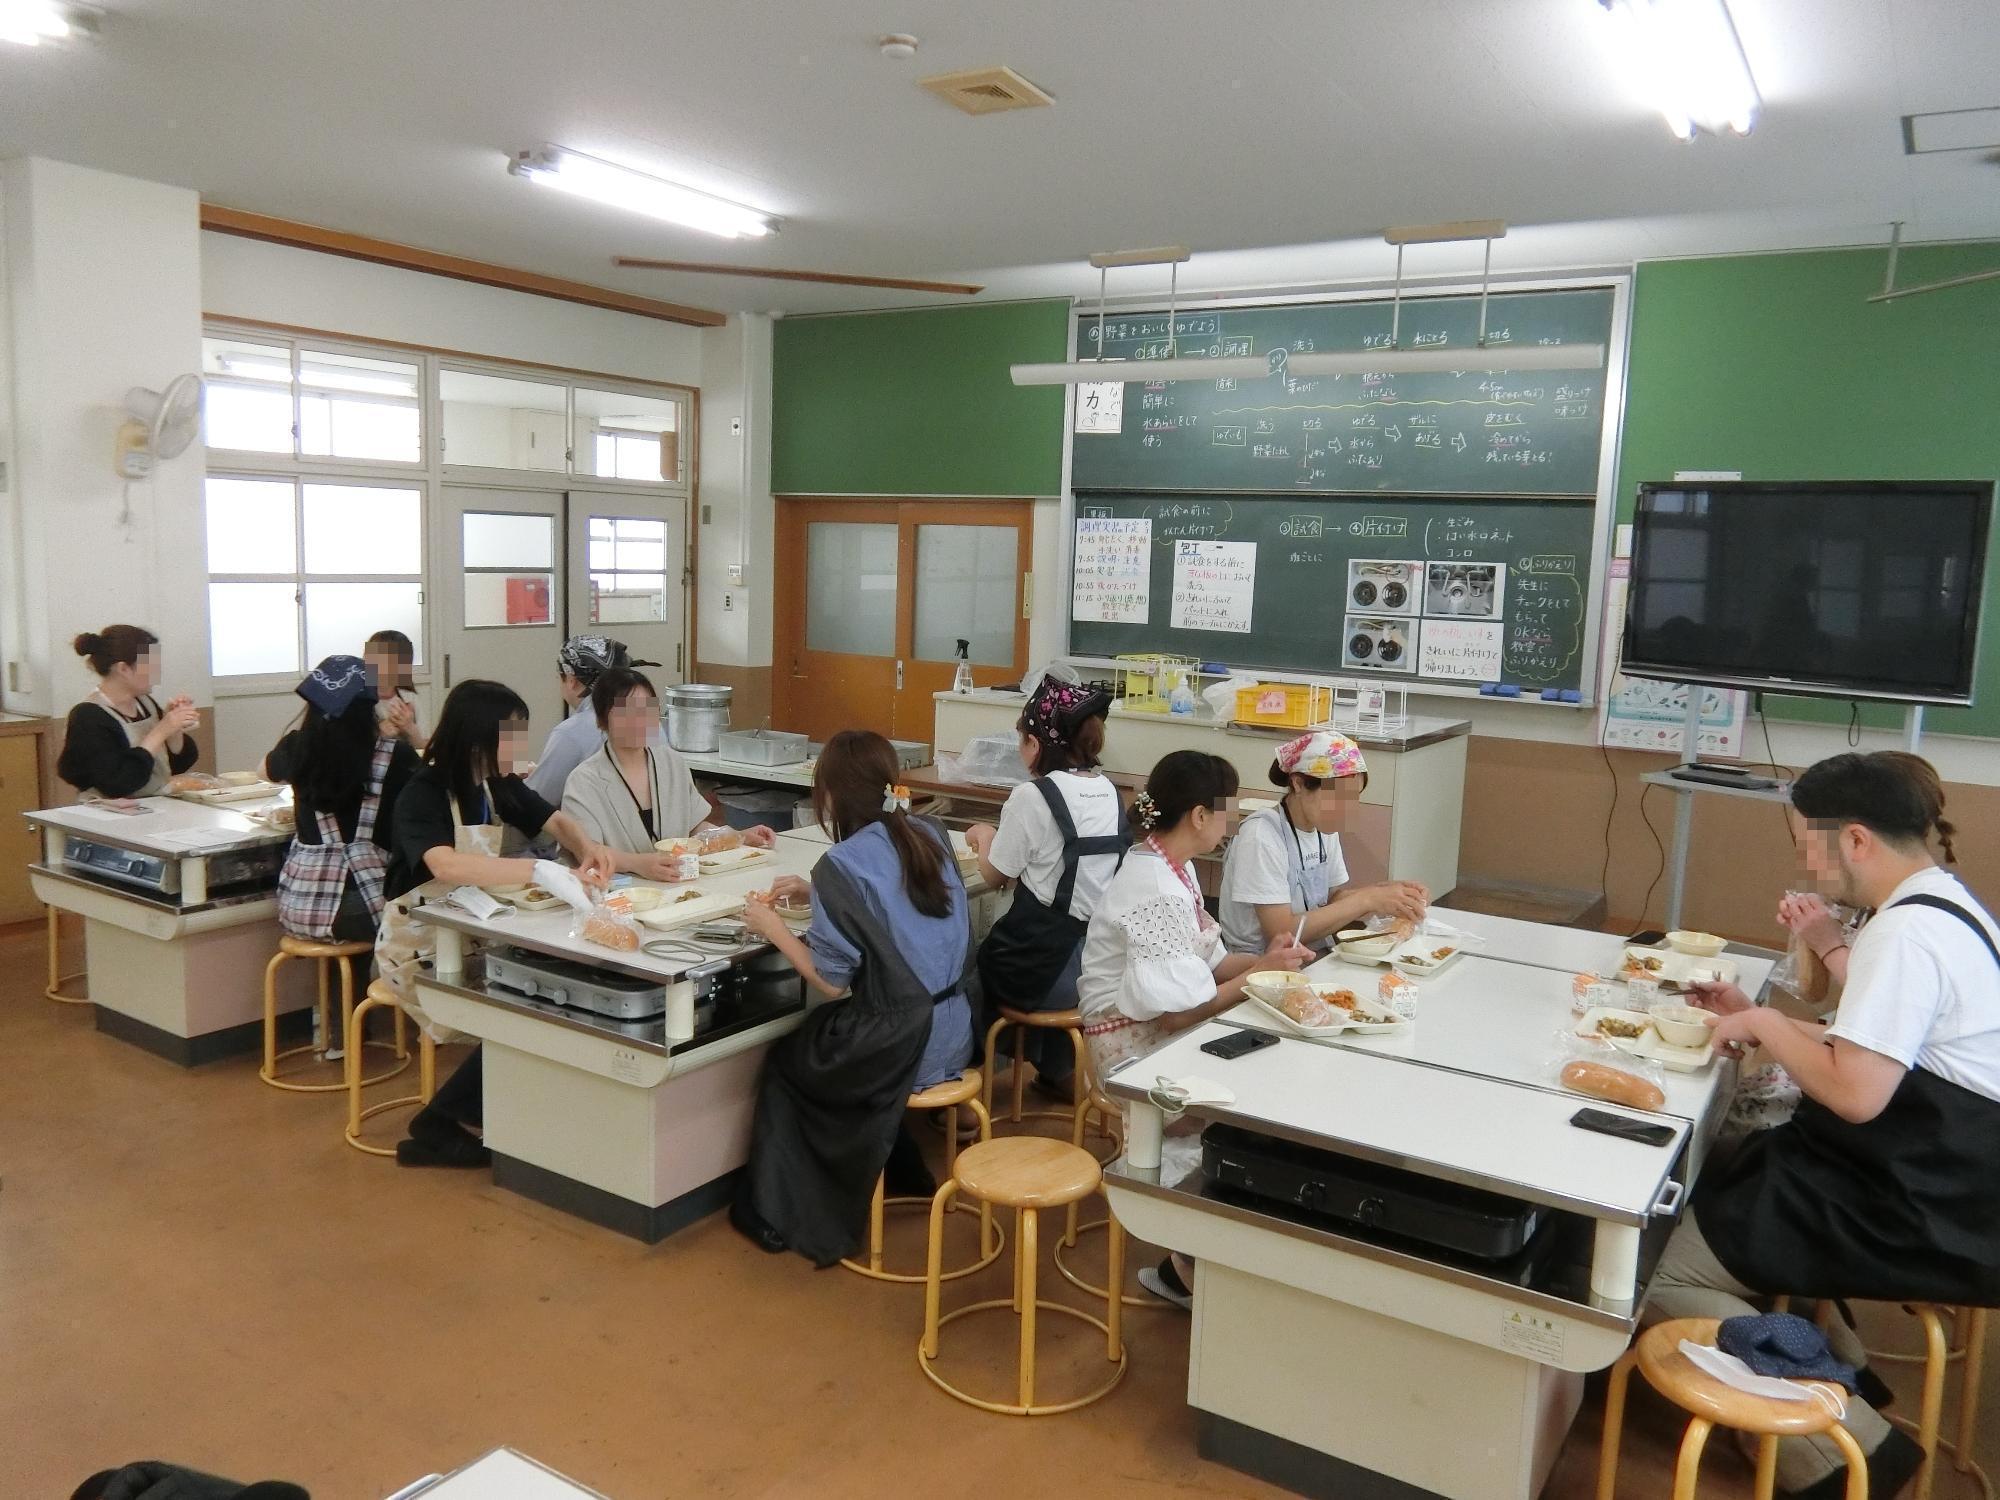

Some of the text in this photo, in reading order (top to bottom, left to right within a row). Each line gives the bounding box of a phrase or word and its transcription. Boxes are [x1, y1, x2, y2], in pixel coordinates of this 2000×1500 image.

[1363, 333, 1391, 346] ゆでる
[1143, 394, 1175, 410] 簡単に
[1352, 414, 1376, 427] ゆでる
[1142, 434, 1163, 448] 使う
[1415, 431, 1441, 445] あげる
[1159, 503, 1212, 519] 試食の前に
[1446, 517, 1475, 528] 生ごみ
[1180, 541, 1201, 555] 包丁
[1517, 578, 1549, 592] 先生に
[1515, 610, 1548, 625] もらって
